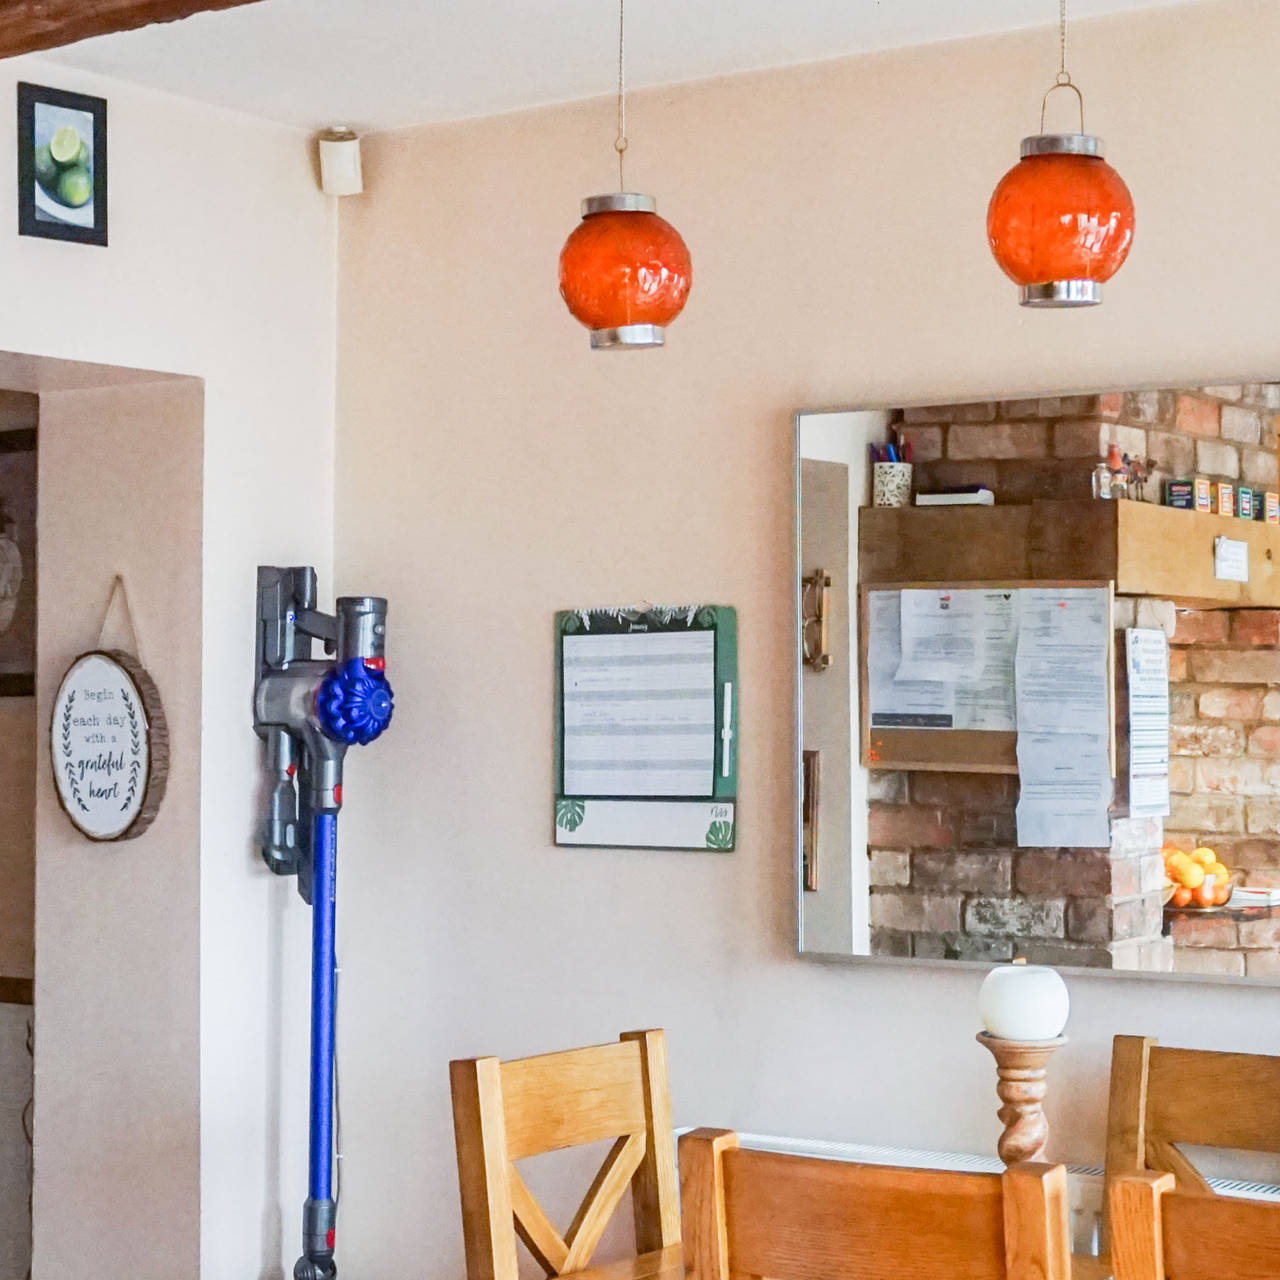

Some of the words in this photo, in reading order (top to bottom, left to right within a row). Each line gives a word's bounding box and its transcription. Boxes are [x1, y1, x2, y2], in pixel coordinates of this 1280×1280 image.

[83, 688, 115, 703] Begin
[73, 714, 100, 727] each
[106, 713, 127, 728] day
[84, 732, 106, 744] with
[110, 735, 117, 743] a
[78, 751, 124, 781] grateful
[89, 780, 120, 800] heart
